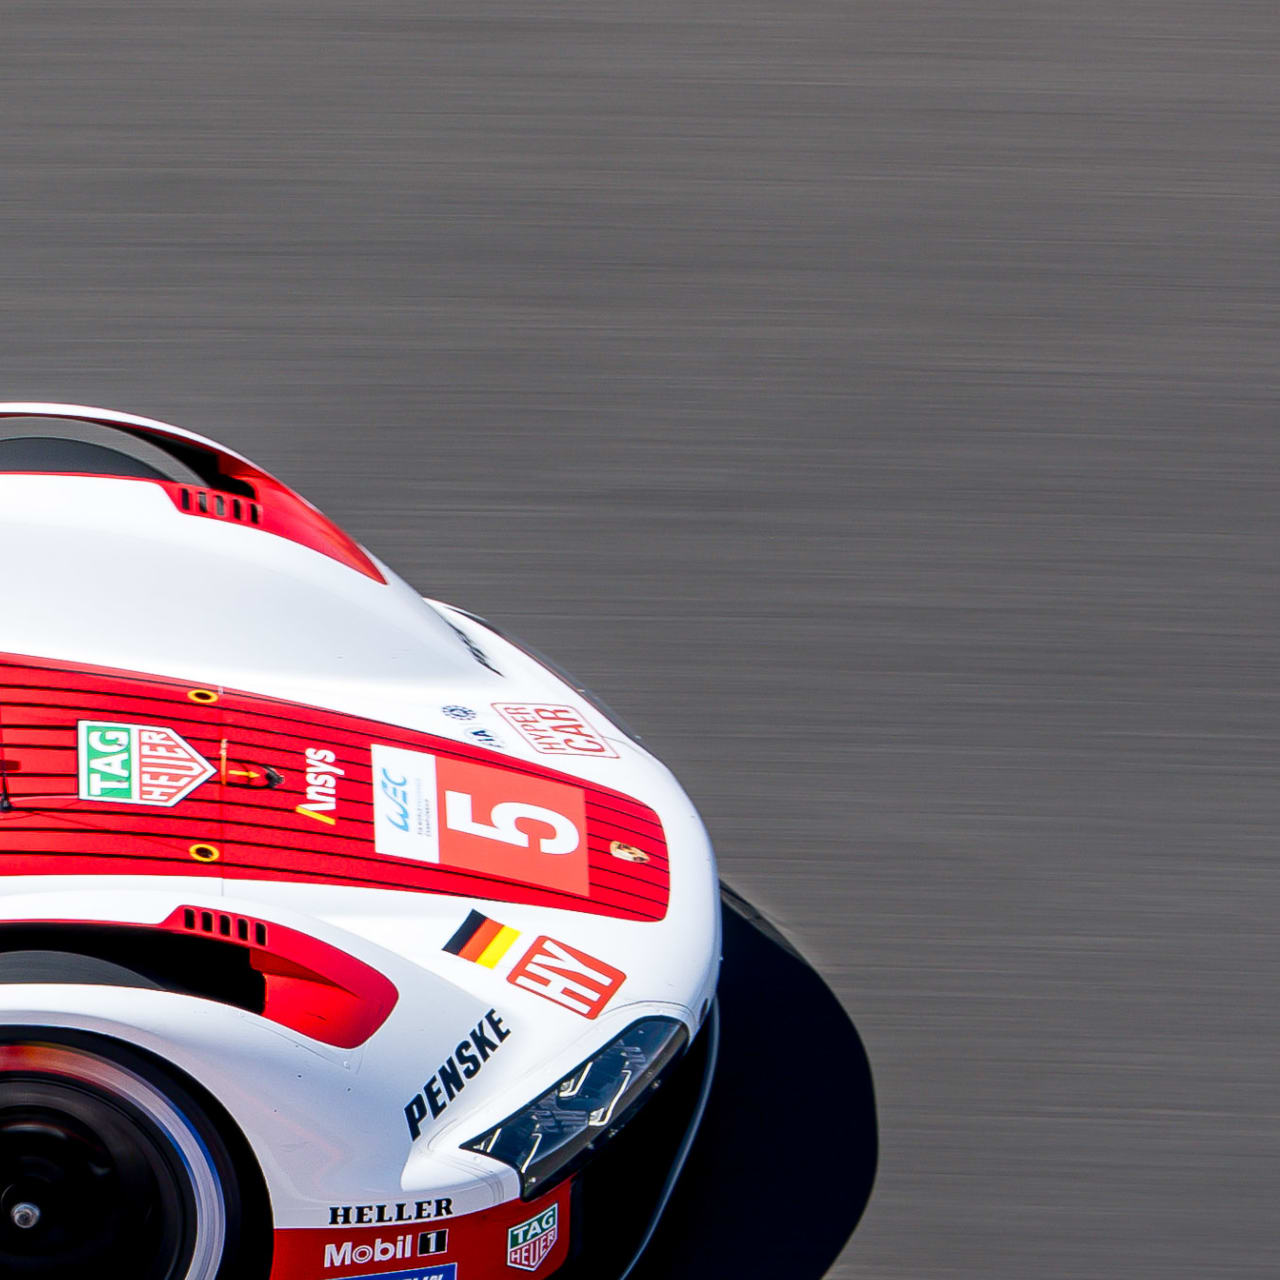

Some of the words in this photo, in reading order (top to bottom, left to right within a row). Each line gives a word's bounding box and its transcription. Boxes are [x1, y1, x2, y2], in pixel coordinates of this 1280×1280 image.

[503, 706, 567, 751] HYPER
[534, 708, 605, 753] CAR
[88, 730, 130, 796] TAG
[141, 731, 206, 801] HEUER
[295, 747, 345, 826] Ansys
[381, 768, 409, 833] WEC
[444, 789, 580, 856] 5
[515, 940, 614, 1015] HY
[403, 1008, 512, 1142] PENSKE
[328, 1197, 453, 1225] HELLER
[512, 1210, 554, 1244] TAG
[324, 1234, 413, 1269] Mobil
[511, 1230, 555, 1267] HEUER
